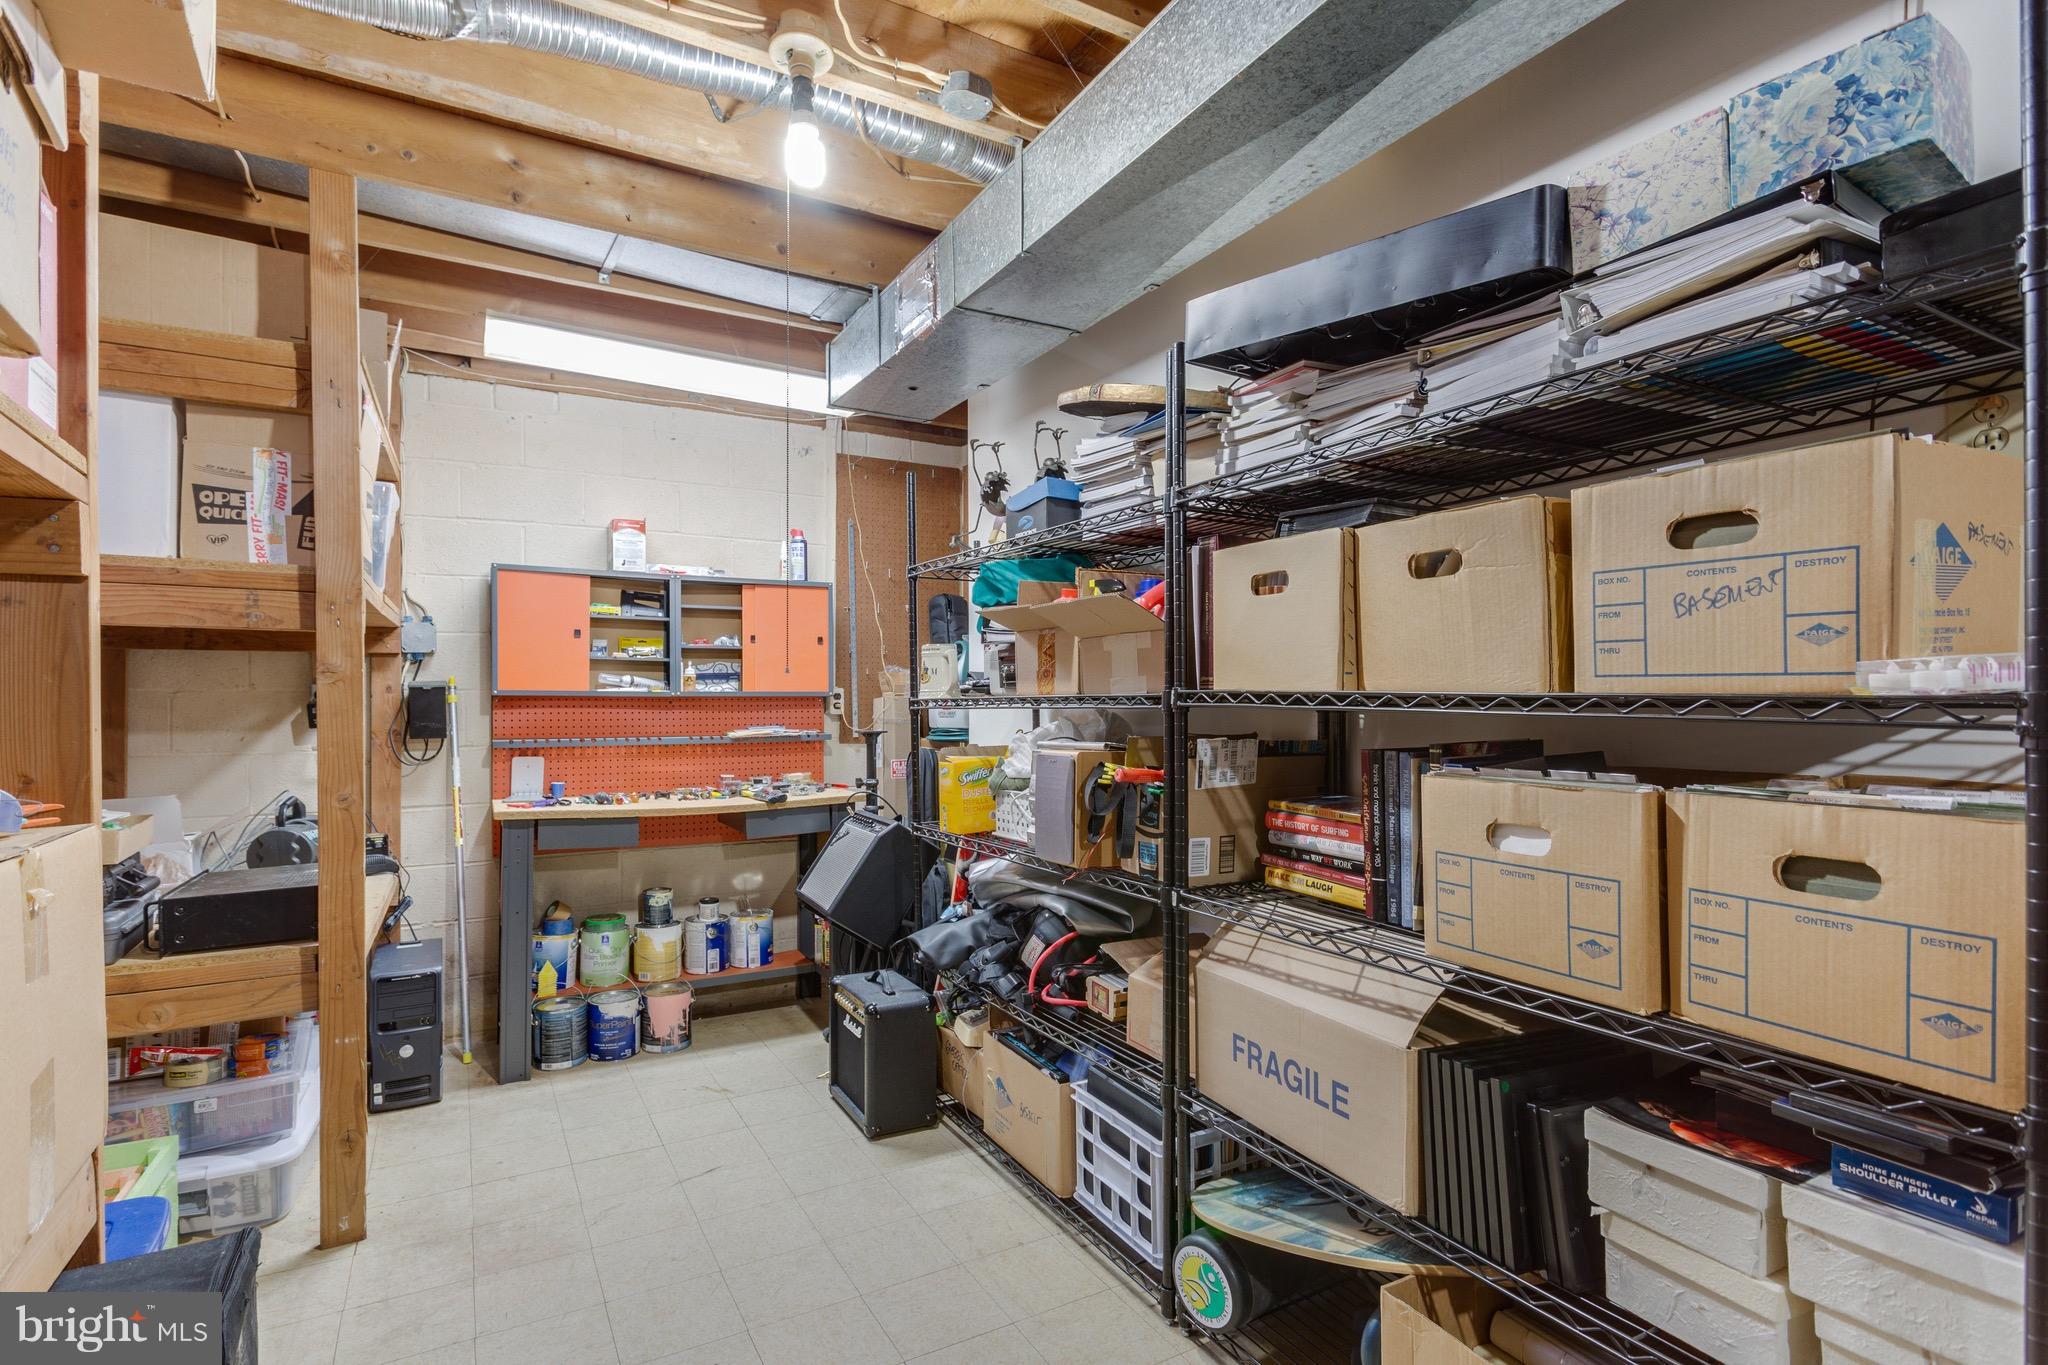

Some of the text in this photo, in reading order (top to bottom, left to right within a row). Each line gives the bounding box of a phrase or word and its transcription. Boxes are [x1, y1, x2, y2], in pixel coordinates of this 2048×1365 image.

[199, 490, 246, 507] OPE
[1794, 556, 1847, 568] DESTROY
[1686, 566, 1737, 578] CONTENTS
[1597, 577, 1614, 586] BOX
[1672, 568, 1785, 619] BASEMENT
[1598, 611, 1621, 619] FROM
[1598, 647, 1621, 655] THRU
[959, 768, 993, 786] Swiffer
[1272, 817, 1349, 838] THE HISTORY OF SURFING
[1310, 853, 1323, 863] WAY
[1333, 858, 1353, 870] WORK
[1268, 869, 1291, 882] MAKE
[1305, 879, 1334, 894] LAUGH
[1499, 868, 1536, 881] CONTENTS
[1439, 887, 1456, 896] FROM
[1574, 881, 1612, 893] DESTROY
[1390, 897, 1398, 918] 1984
[1693, 896, 1732, 910] BOX NO.
[1439, 917, 1456, 927] THRU
[1794, 914, 1854, 932] CONTENTS
[1693, 933, 1720, 945] FROM
[1919, 936, 1982, 954] DESTROY
[1693, 972, 1718, 985] THRU
[1930, 1016, 1968, 1031] PAIGE
[1232, 1033, 1350, 1120] FRAGILE
[1862, 1163, 1929, 1189] HOME RANGER
[1839, 1162, 1957, 1208] SHOULDER PULLEY
[1966, 1210, 1998, 1227] PrePak
